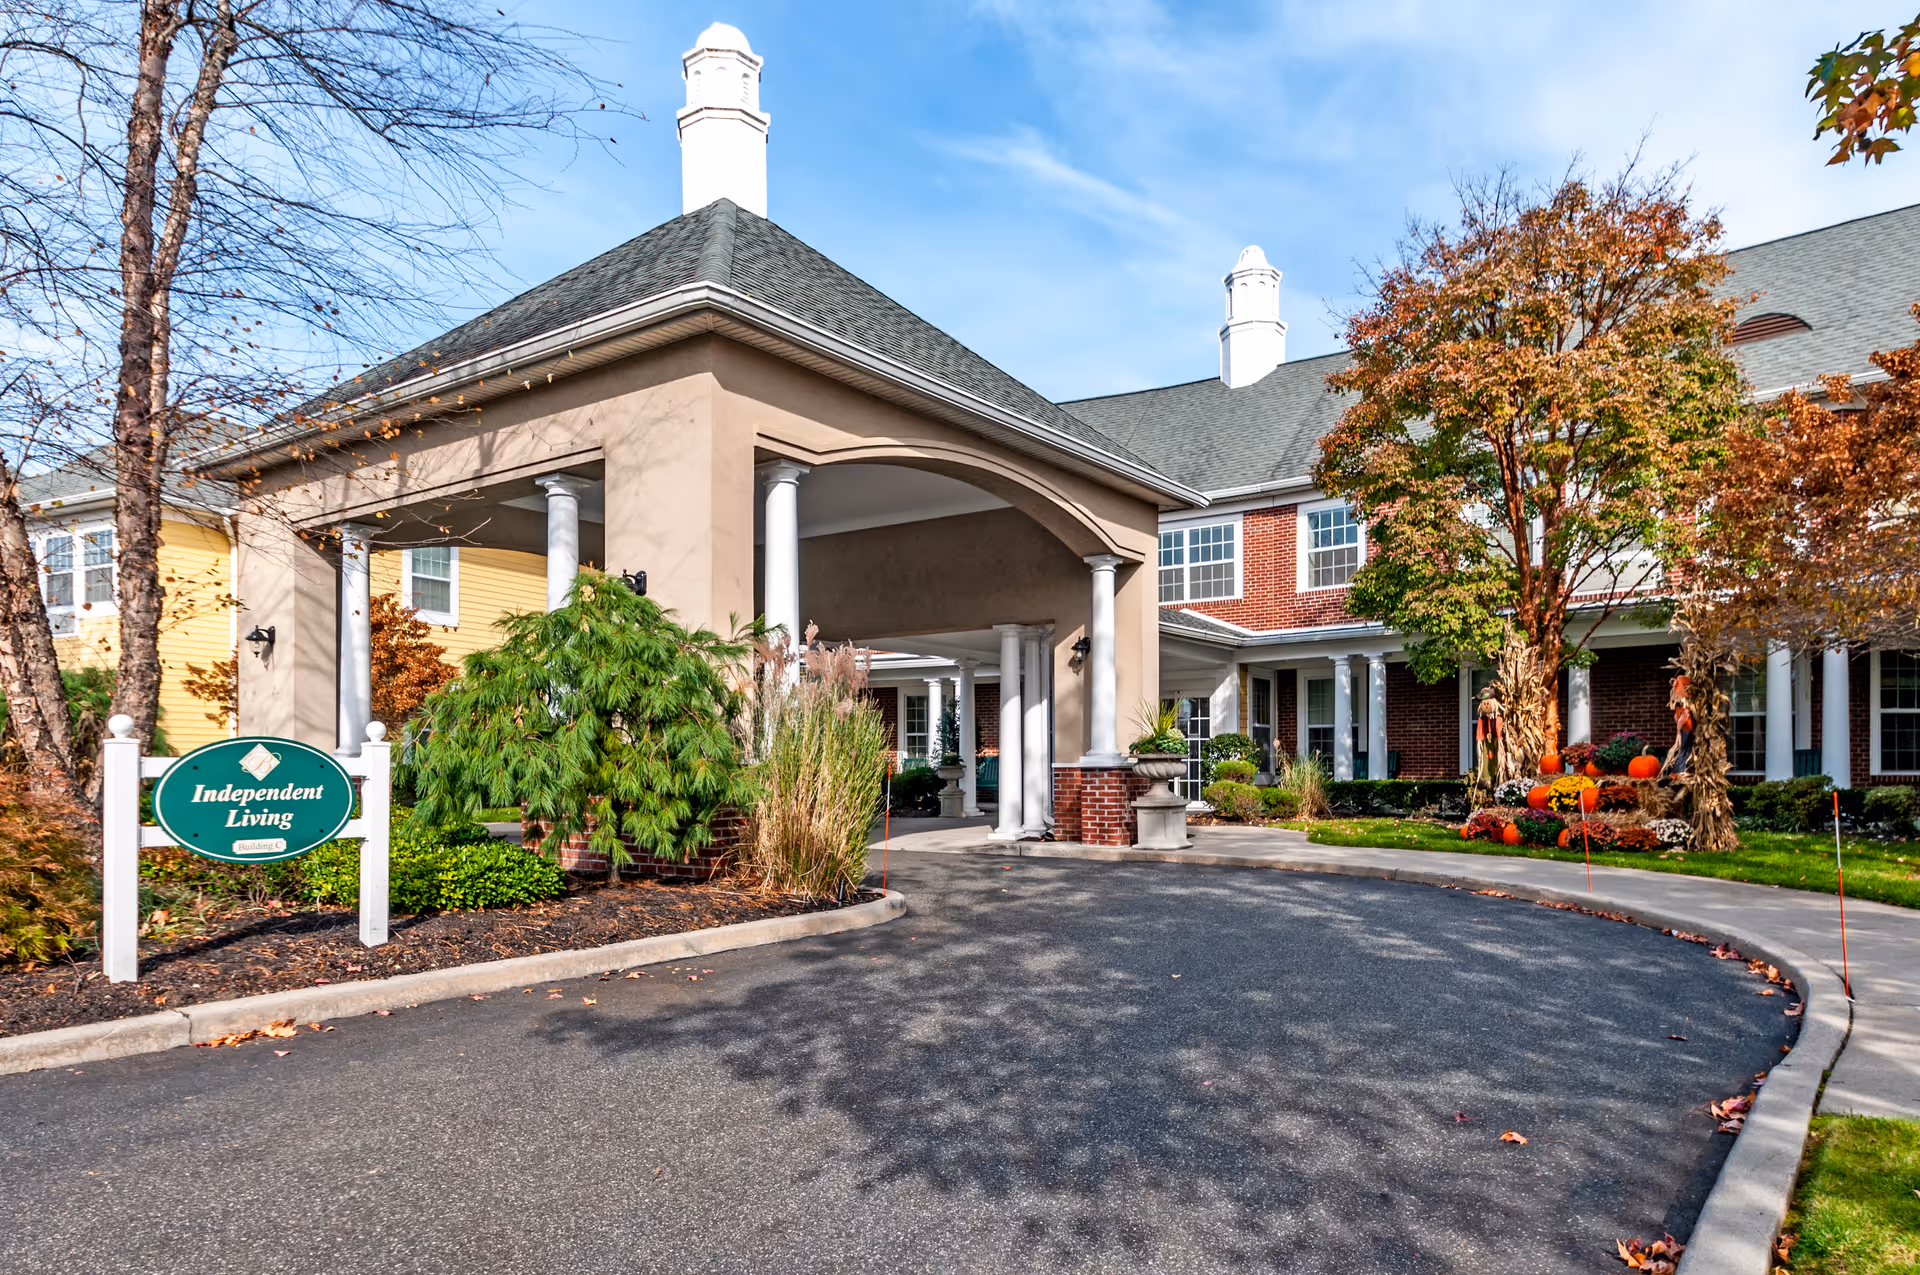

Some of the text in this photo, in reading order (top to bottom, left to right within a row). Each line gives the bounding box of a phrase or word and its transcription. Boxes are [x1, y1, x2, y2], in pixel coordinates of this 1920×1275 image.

[190, 782, 324, 807] Independent
[224, 808, 294, 830] Living
[238, 841, 284, 852] Building C
